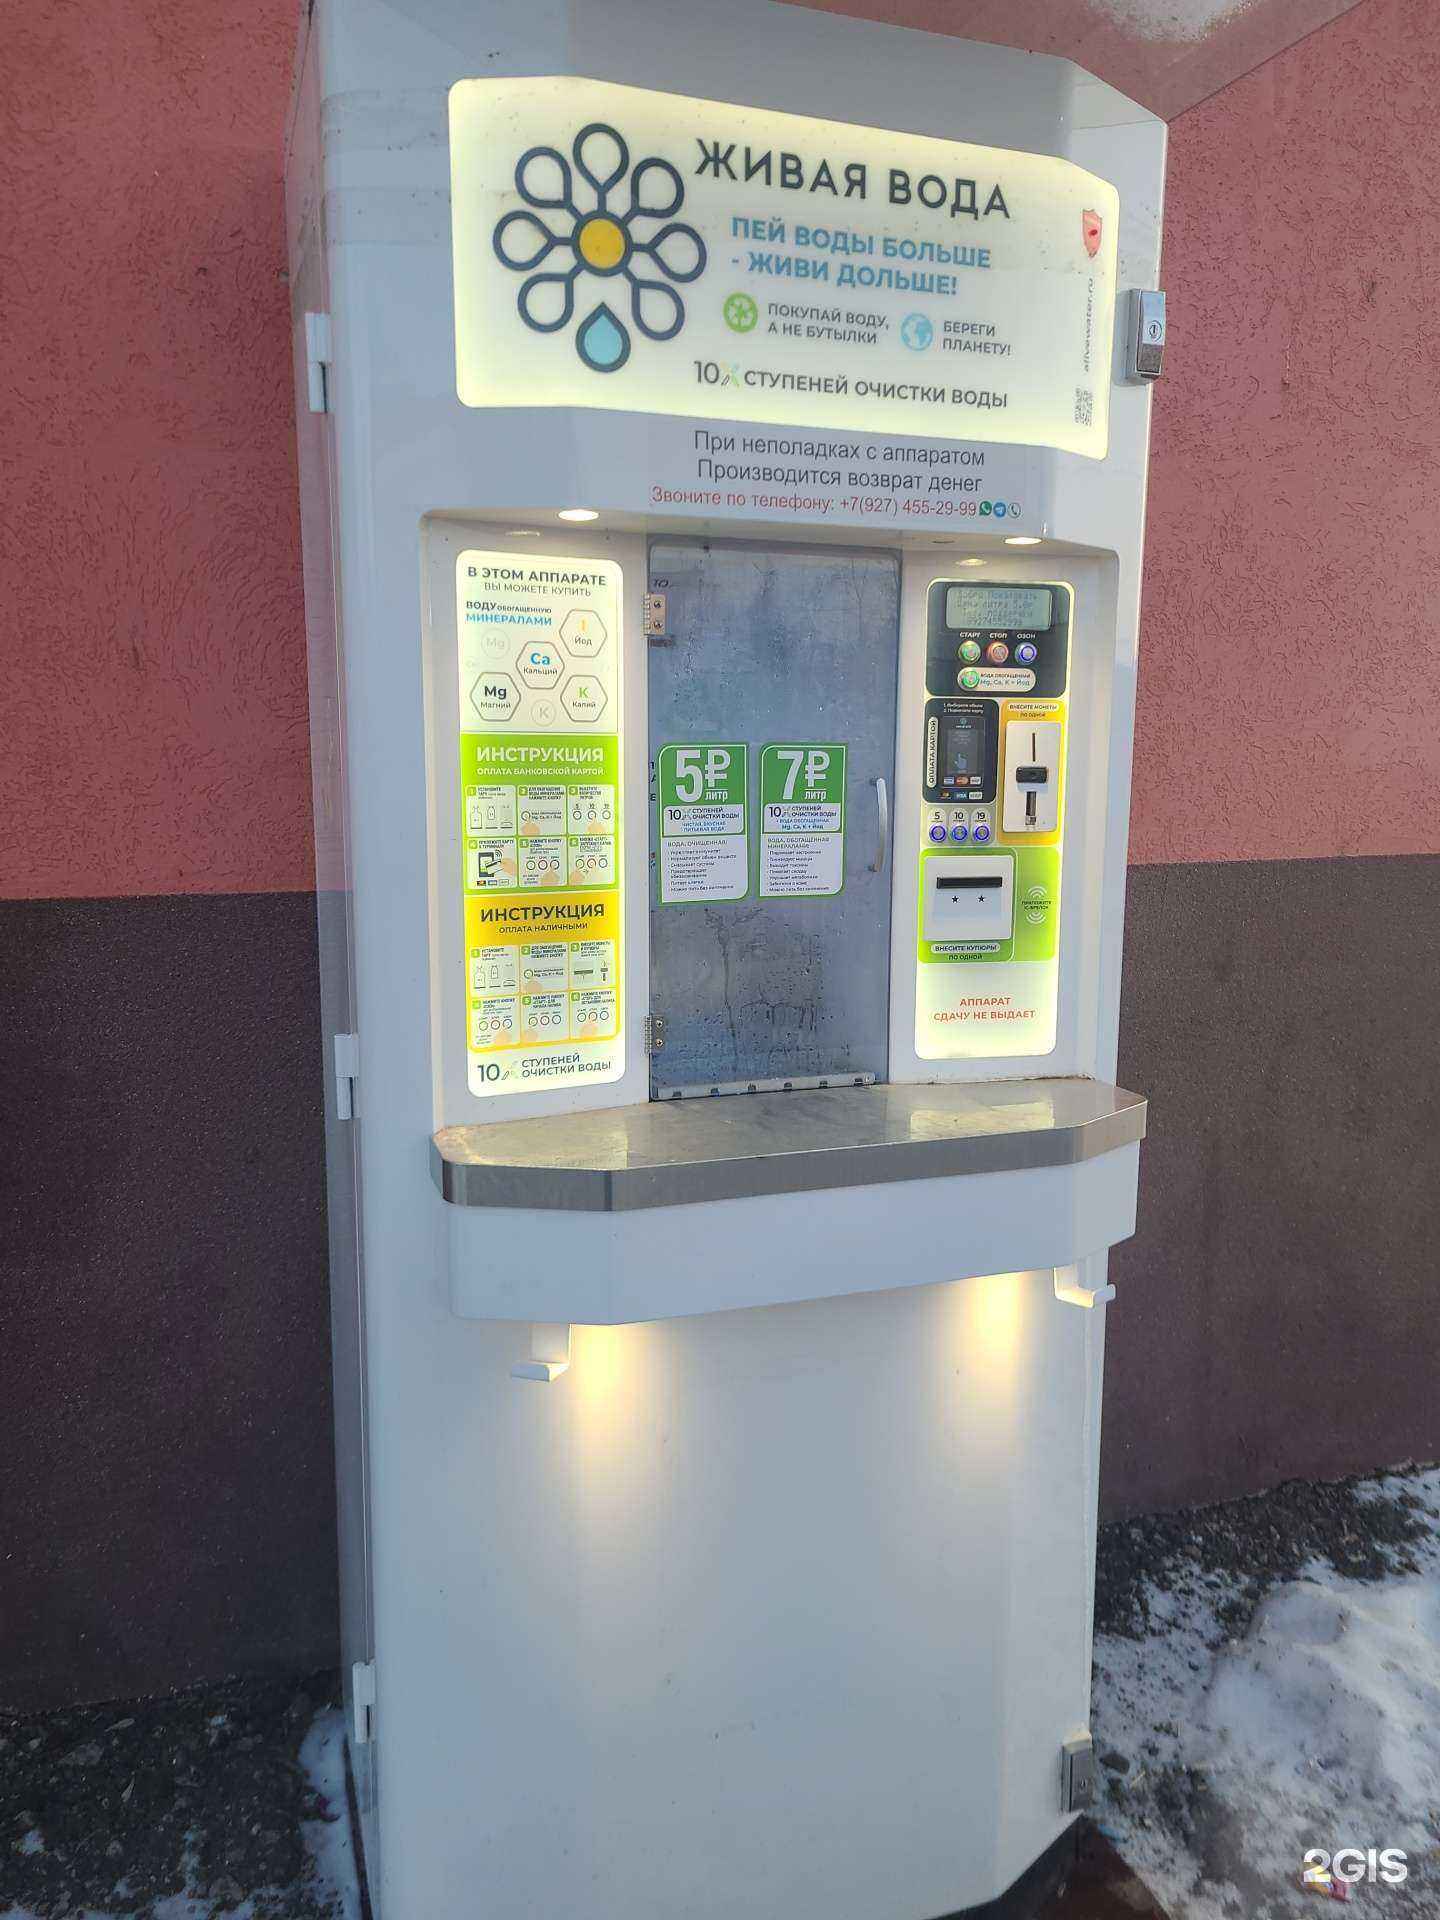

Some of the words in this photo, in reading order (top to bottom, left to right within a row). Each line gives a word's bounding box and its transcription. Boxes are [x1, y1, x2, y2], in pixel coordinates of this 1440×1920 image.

[695, 138, 866, 199] ЖИВАЯ
[889, 168, 1010, 220] ВОДА
[731, 216, 785, 243] ПЕЙ
[794, 225, 873, 255] ВОДЫ
[882, 236, 991, 268] БОЛЬШЕ
[748, 252, 828, 281] ЖИВИ
[836, 264, 957, 295] ДОЛЬШЕ!
[767, 303, 840, 323] ПОКУПАЙ
[845, 312, 889, 330] ВОДУ,
[767, 324, 778, 334] А
[783, 324, 801, 337] НЕ
[806, 326, 877, 345] БУТЫЛКИ
[943, 320, 995, 337] БЕРЕГИ
[942, 338, 1011, 356] ПЛАНЕТУ!
[693, 360, 719, 384] 10
[744, 369, 848, 395] СТУПЕНЕЙ
[855, 380, 945, 401] ОЧИСТКИ
[951, 389, 1008, 409] ВОДЫ
[694, 430, 735, 454] При
[743, 435, 860, 461] неполадках
[867, 445, 877, 460] с
[883, 446, 985, 467] аппаратом
[698, 459, 841, 487] Производится
[848, 469, 922, 493] возврат
[928, 474, 983, 493] денег
[652, 486, 721, 505] Звоните
[727, 493, 746, 507] по
[752, 493, 834, 515] телефону:
[840, 496, 898, 516] +7(927)
[902, 499, 977, 516] 455-29-99
[468, 566, 477, 577] В
[482, 567, 524, 580] ЭТОМ
[529, 571, 607, 586] АППАРАТЕ
[484, 582, 501, 591] ВЫ
[504, 583, 548, 594] МОЖЕТЕ
[551, 587, 591, 597] КУПИТЬ
[466, 601, 497, 613] ВОДУ
[466, 613, 552, 626] МИНЕРАЛАМИ
[574, 635, 592, 647] Йод
[959, 631, 981, 639] СТАРТ
[530, 653, 550, 665] Ca
[523, 667, 558, 676] Кальций
[484, 686, 507, 700] Mg
[481, 701, 511, 709] Магний
[572, 700, 596, 709] Калий
[928, 720, 936, 751] КАРТОЙ
[477, 746, 604, 764] ИНСТРУКЦИЯ
[477, 768, 512, 776] ОПЛАТА
[514, 766, 570, 776] БАНКОВСКОЙ
[572, 767, 604, 776] КАРТОЙ
[668, 809, 681, 820] 10
[769, 806, 782, 818] 10
[481, 903, 605, 922] ИНСТРУКЦИЯ
[499, 926, 532, 934] ОПЛАТА
[535, 923, 588, 932] НАЛИЧНЫМИ
[960, 997, 1011, 1006] АППАРАТ
[933, 1011, 970, 1021] СДАЧУ
[973, 1011, 988, 1020] НЕ
[991, 1010, 1035, 1019] ВЫДАЕТ
[477, 1063, 500, 1082] 10
[522, 1053, 580, 1068] СТУПЕНЕЙ
[522, 1066, 573, 1078] ОЧИСТКИ
[579, 1062, 611, 1071] ВОДЫ
